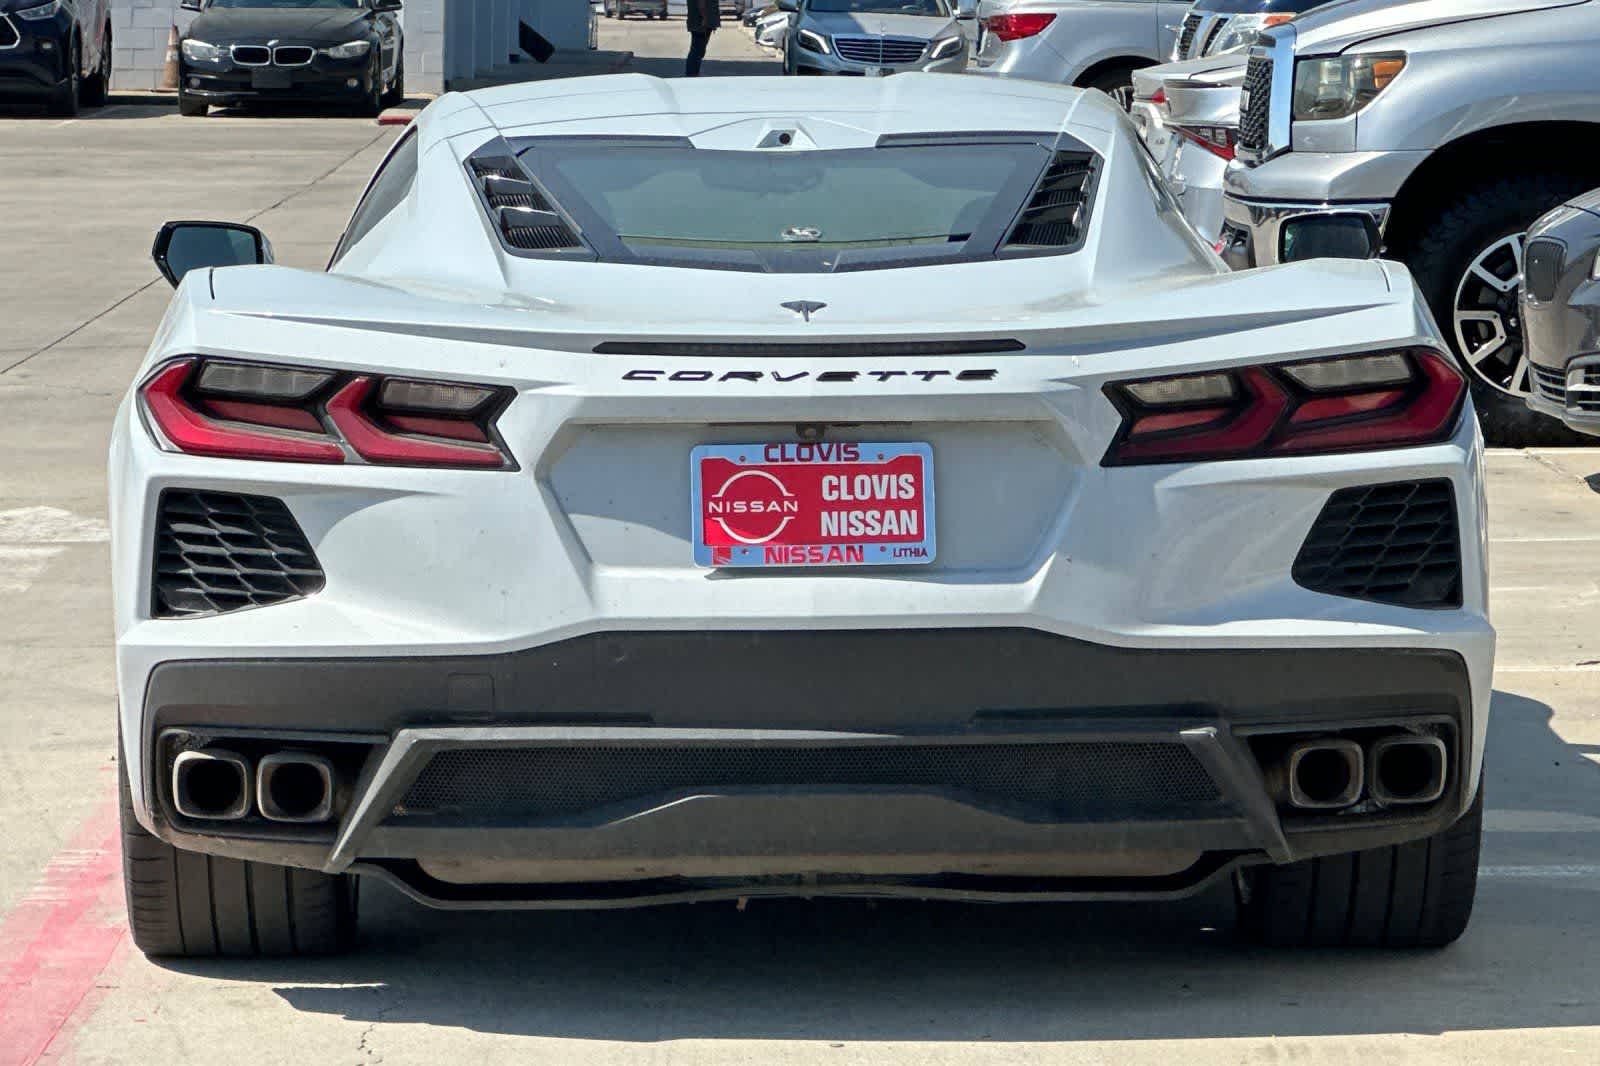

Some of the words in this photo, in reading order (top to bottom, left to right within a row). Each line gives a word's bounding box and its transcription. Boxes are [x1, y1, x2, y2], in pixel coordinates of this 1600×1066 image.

[621, 368, 1000, 382] CORVETTE
[764, 443, 860, 463] CLOVIS
[821, 473, 915, 501] CLOVIS
[708, 500, 798, 513] NISSAN
[821, 509, 918, 537] NISSAN
[765, 545, 864, 564] NISSAN
[892, 547, 928, 558] LITHIA
